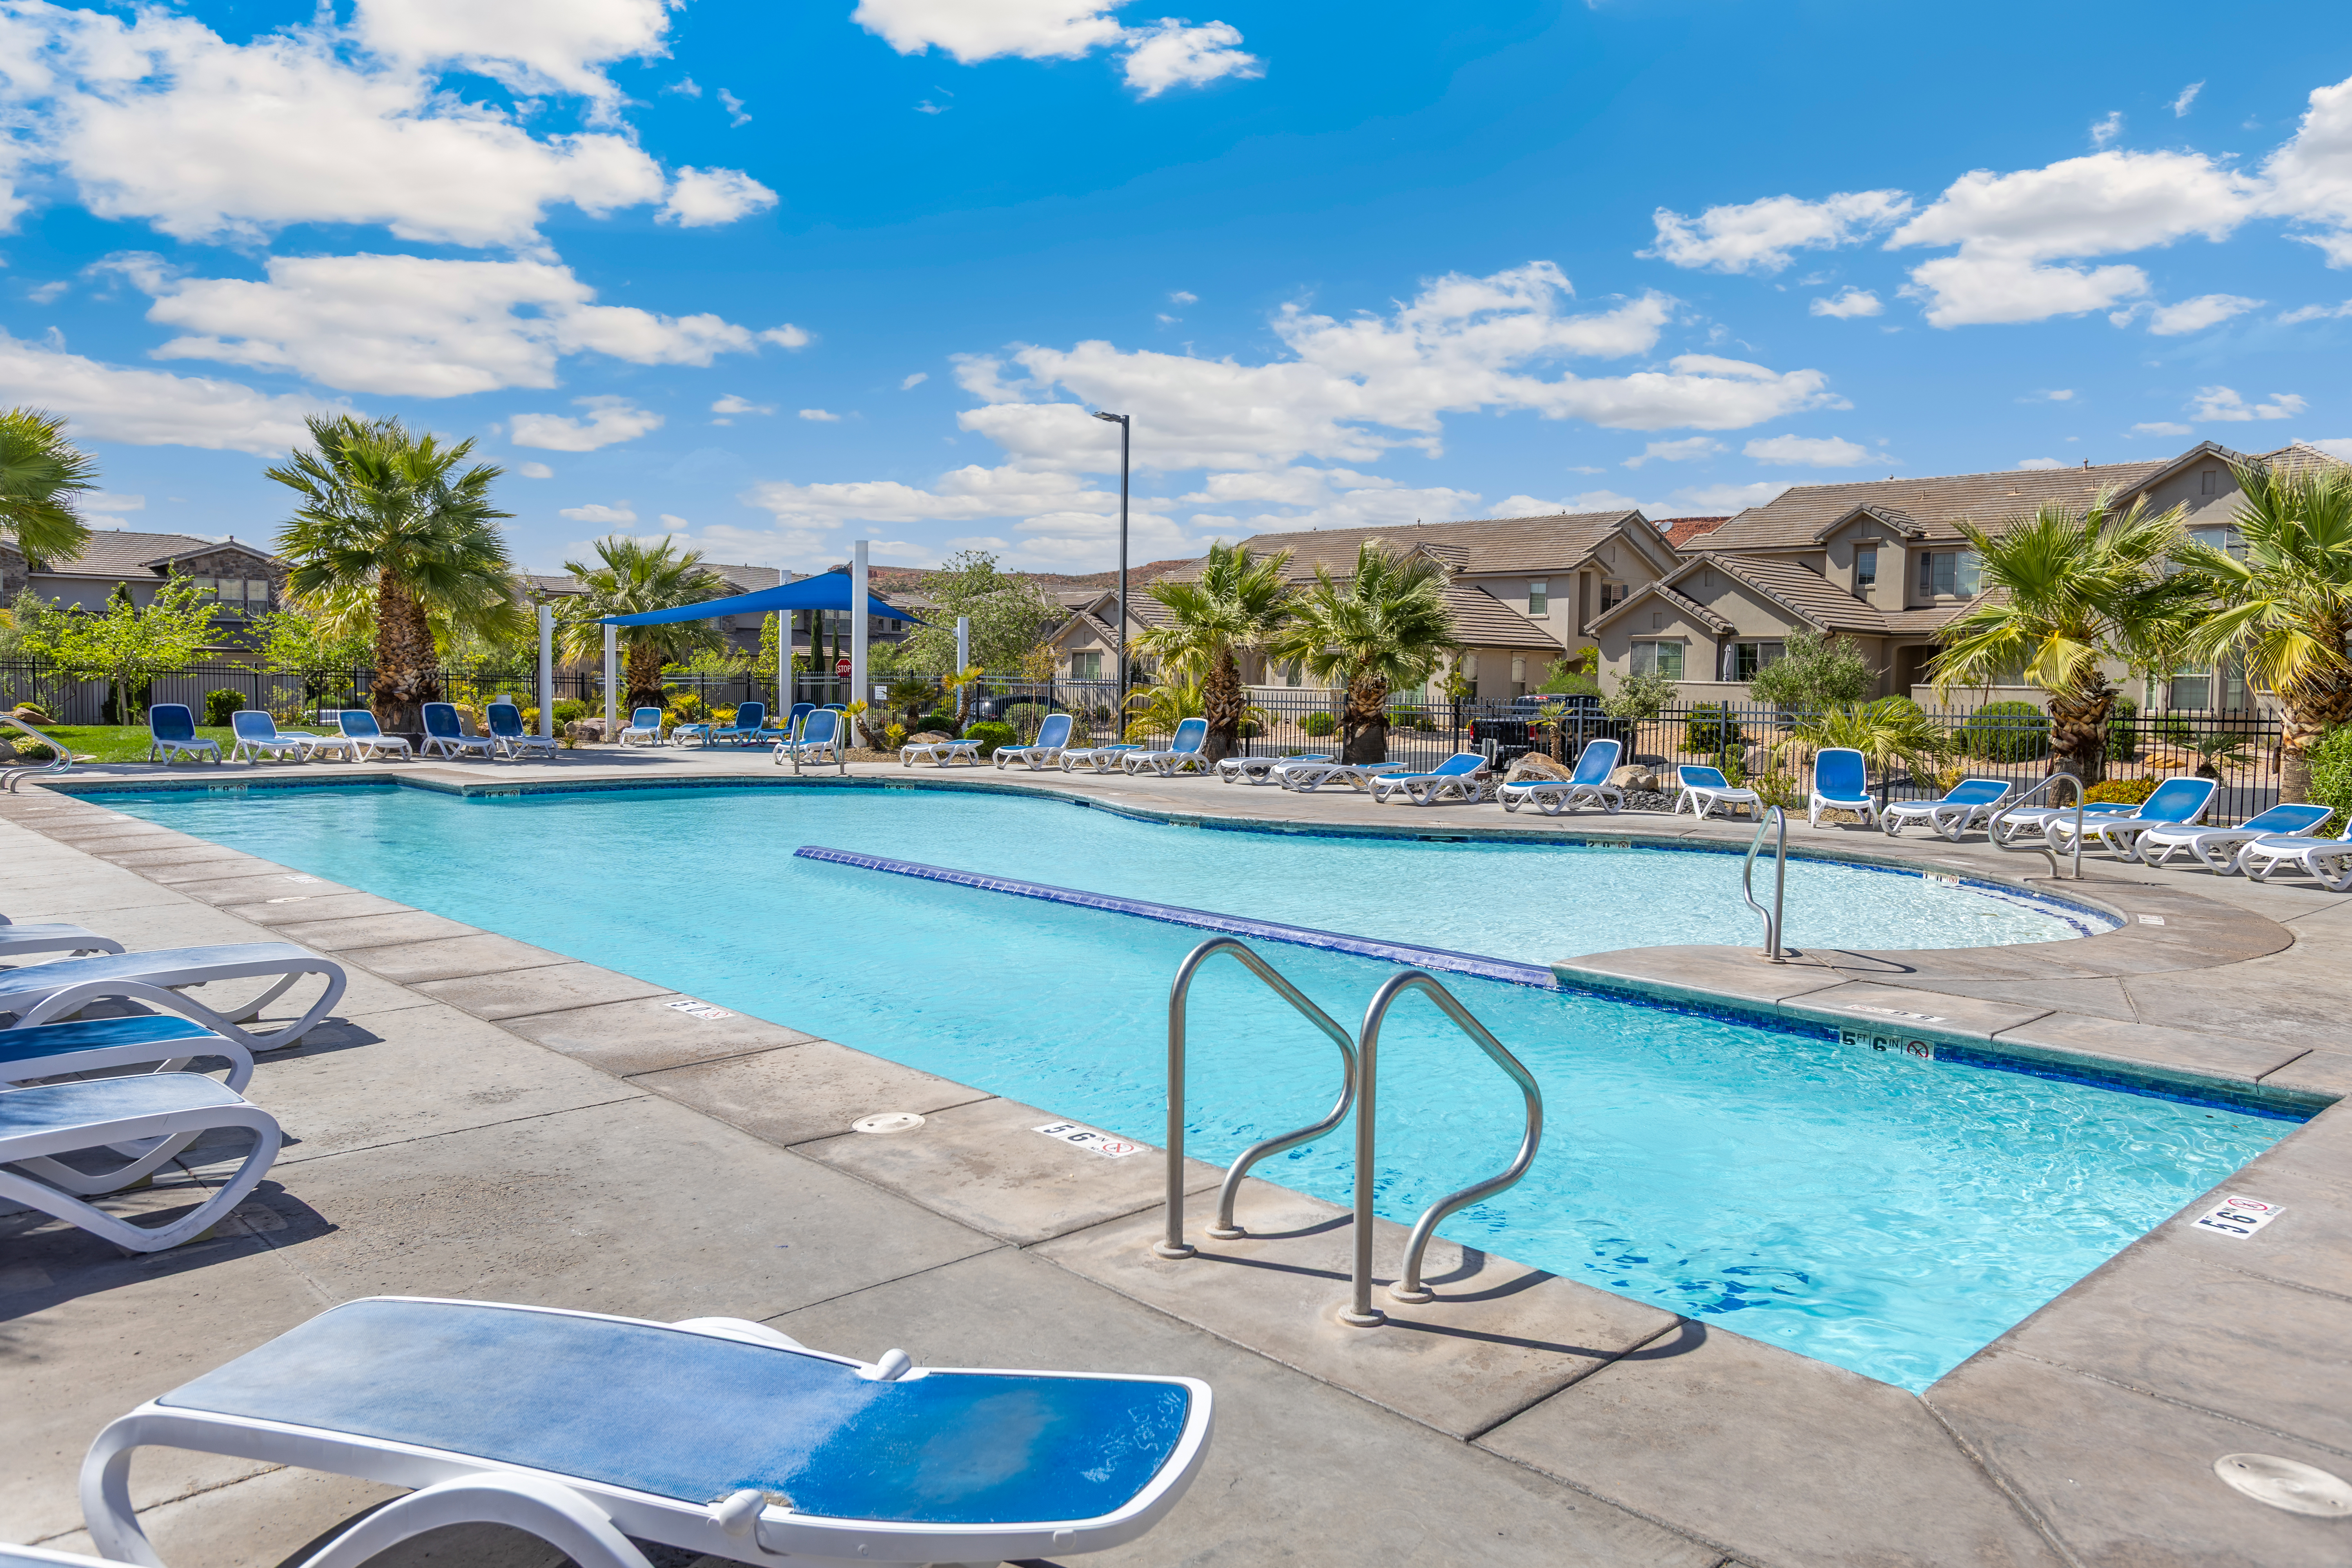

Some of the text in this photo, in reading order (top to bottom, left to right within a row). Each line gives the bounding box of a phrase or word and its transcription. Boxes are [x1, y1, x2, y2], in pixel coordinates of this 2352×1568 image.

[837, 665, 851, 673] STOP
[1842, 1031, 1898, 1051] 5 FT 6 IN
[1043, 1125, 1076, 1133] 5
[1067, 1133, 1096, 1141] 6
[2216, 1211, 2258, 1223] 6
[2199, 1219, 2250, 1234] 5
